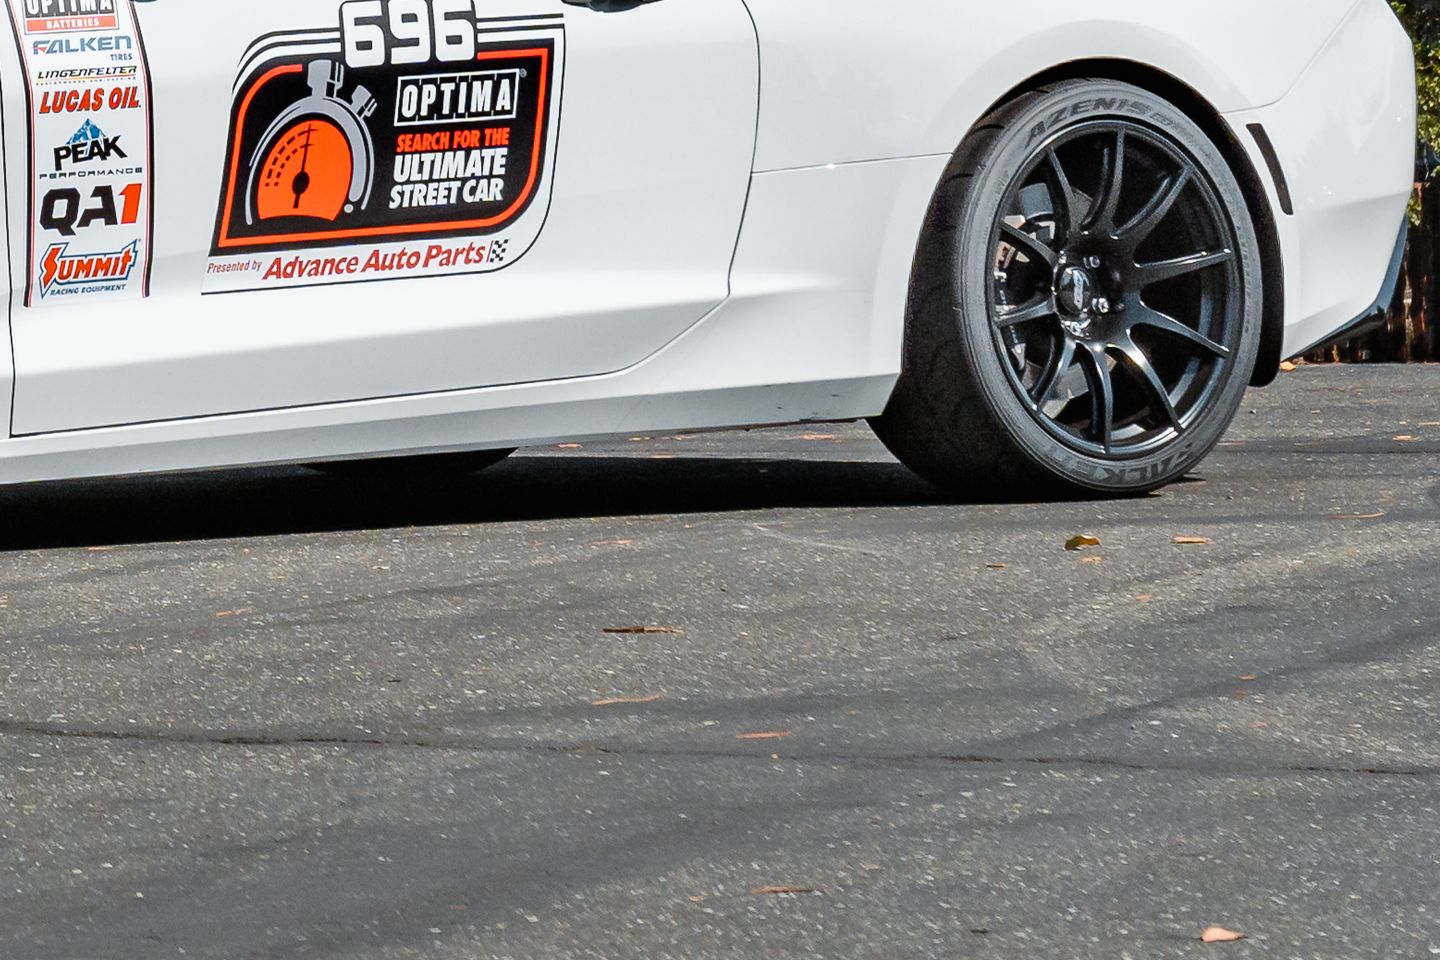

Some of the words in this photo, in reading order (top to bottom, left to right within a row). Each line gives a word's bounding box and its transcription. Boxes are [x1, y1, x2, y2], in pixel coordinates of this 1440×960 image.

[46, 18, 100, 29] BATTERIES
[32, 35, 133, 55] FALKEN
[110, 53, 133, 61] TIRES
[37, 65, 137, 79] LINGENFELTER
[38, 88, 105, 114] LUCAS
[109, 86, 139, 109] OIL
[401, 77, 512, 118] OPTIMA
[396, 131, 450, 152] SEARCH
[453, 130, 480, 148] FOR
[484, 127, 510, 146] THE
[53, 135, 128, 171] PEAK
[393, 147, 508, 183] ULTIMATE
[39, 167, 143, 180] PERFORMANCE
[388, 181, 461, 209] STREET
[462, 178, 504, 203] CAR
[40, 183, 142, 236] QA1
[207, 261, 251, 274] Presented
[252, 259, 262, 272] by
[262, 255, 359, 280] Advance
[360, 247, 421, 272] Auto
[422, 242, 486, 267] Parts
[50, 286, 79, 296] RACING
[81, 284, 126, 294] EQUIPMENT
